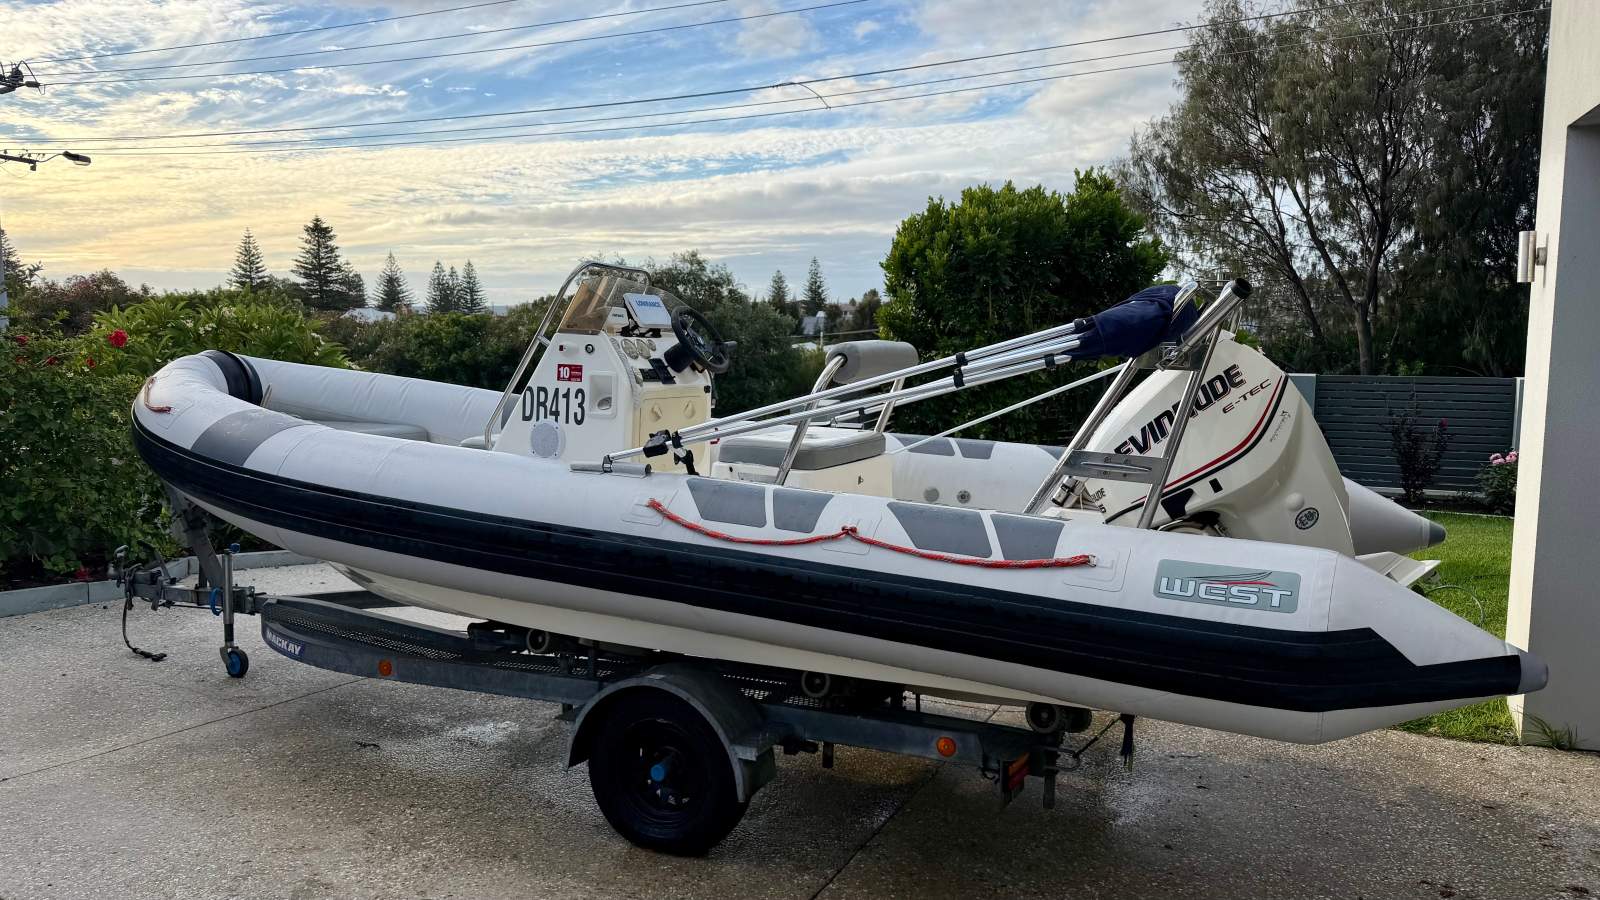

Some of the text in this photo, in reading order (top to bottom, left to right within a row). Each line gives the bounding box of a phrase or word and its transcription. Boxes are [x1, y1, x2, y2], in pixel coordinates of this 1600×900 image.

[558, 366, 570, 379] 10
[521, 385, 586, 426] DR413
[1222, 378, 1272, 414] E-TEC
[1159, 576, 1292, 607] WEST
[266, 628, 301, 655] MACKAY
